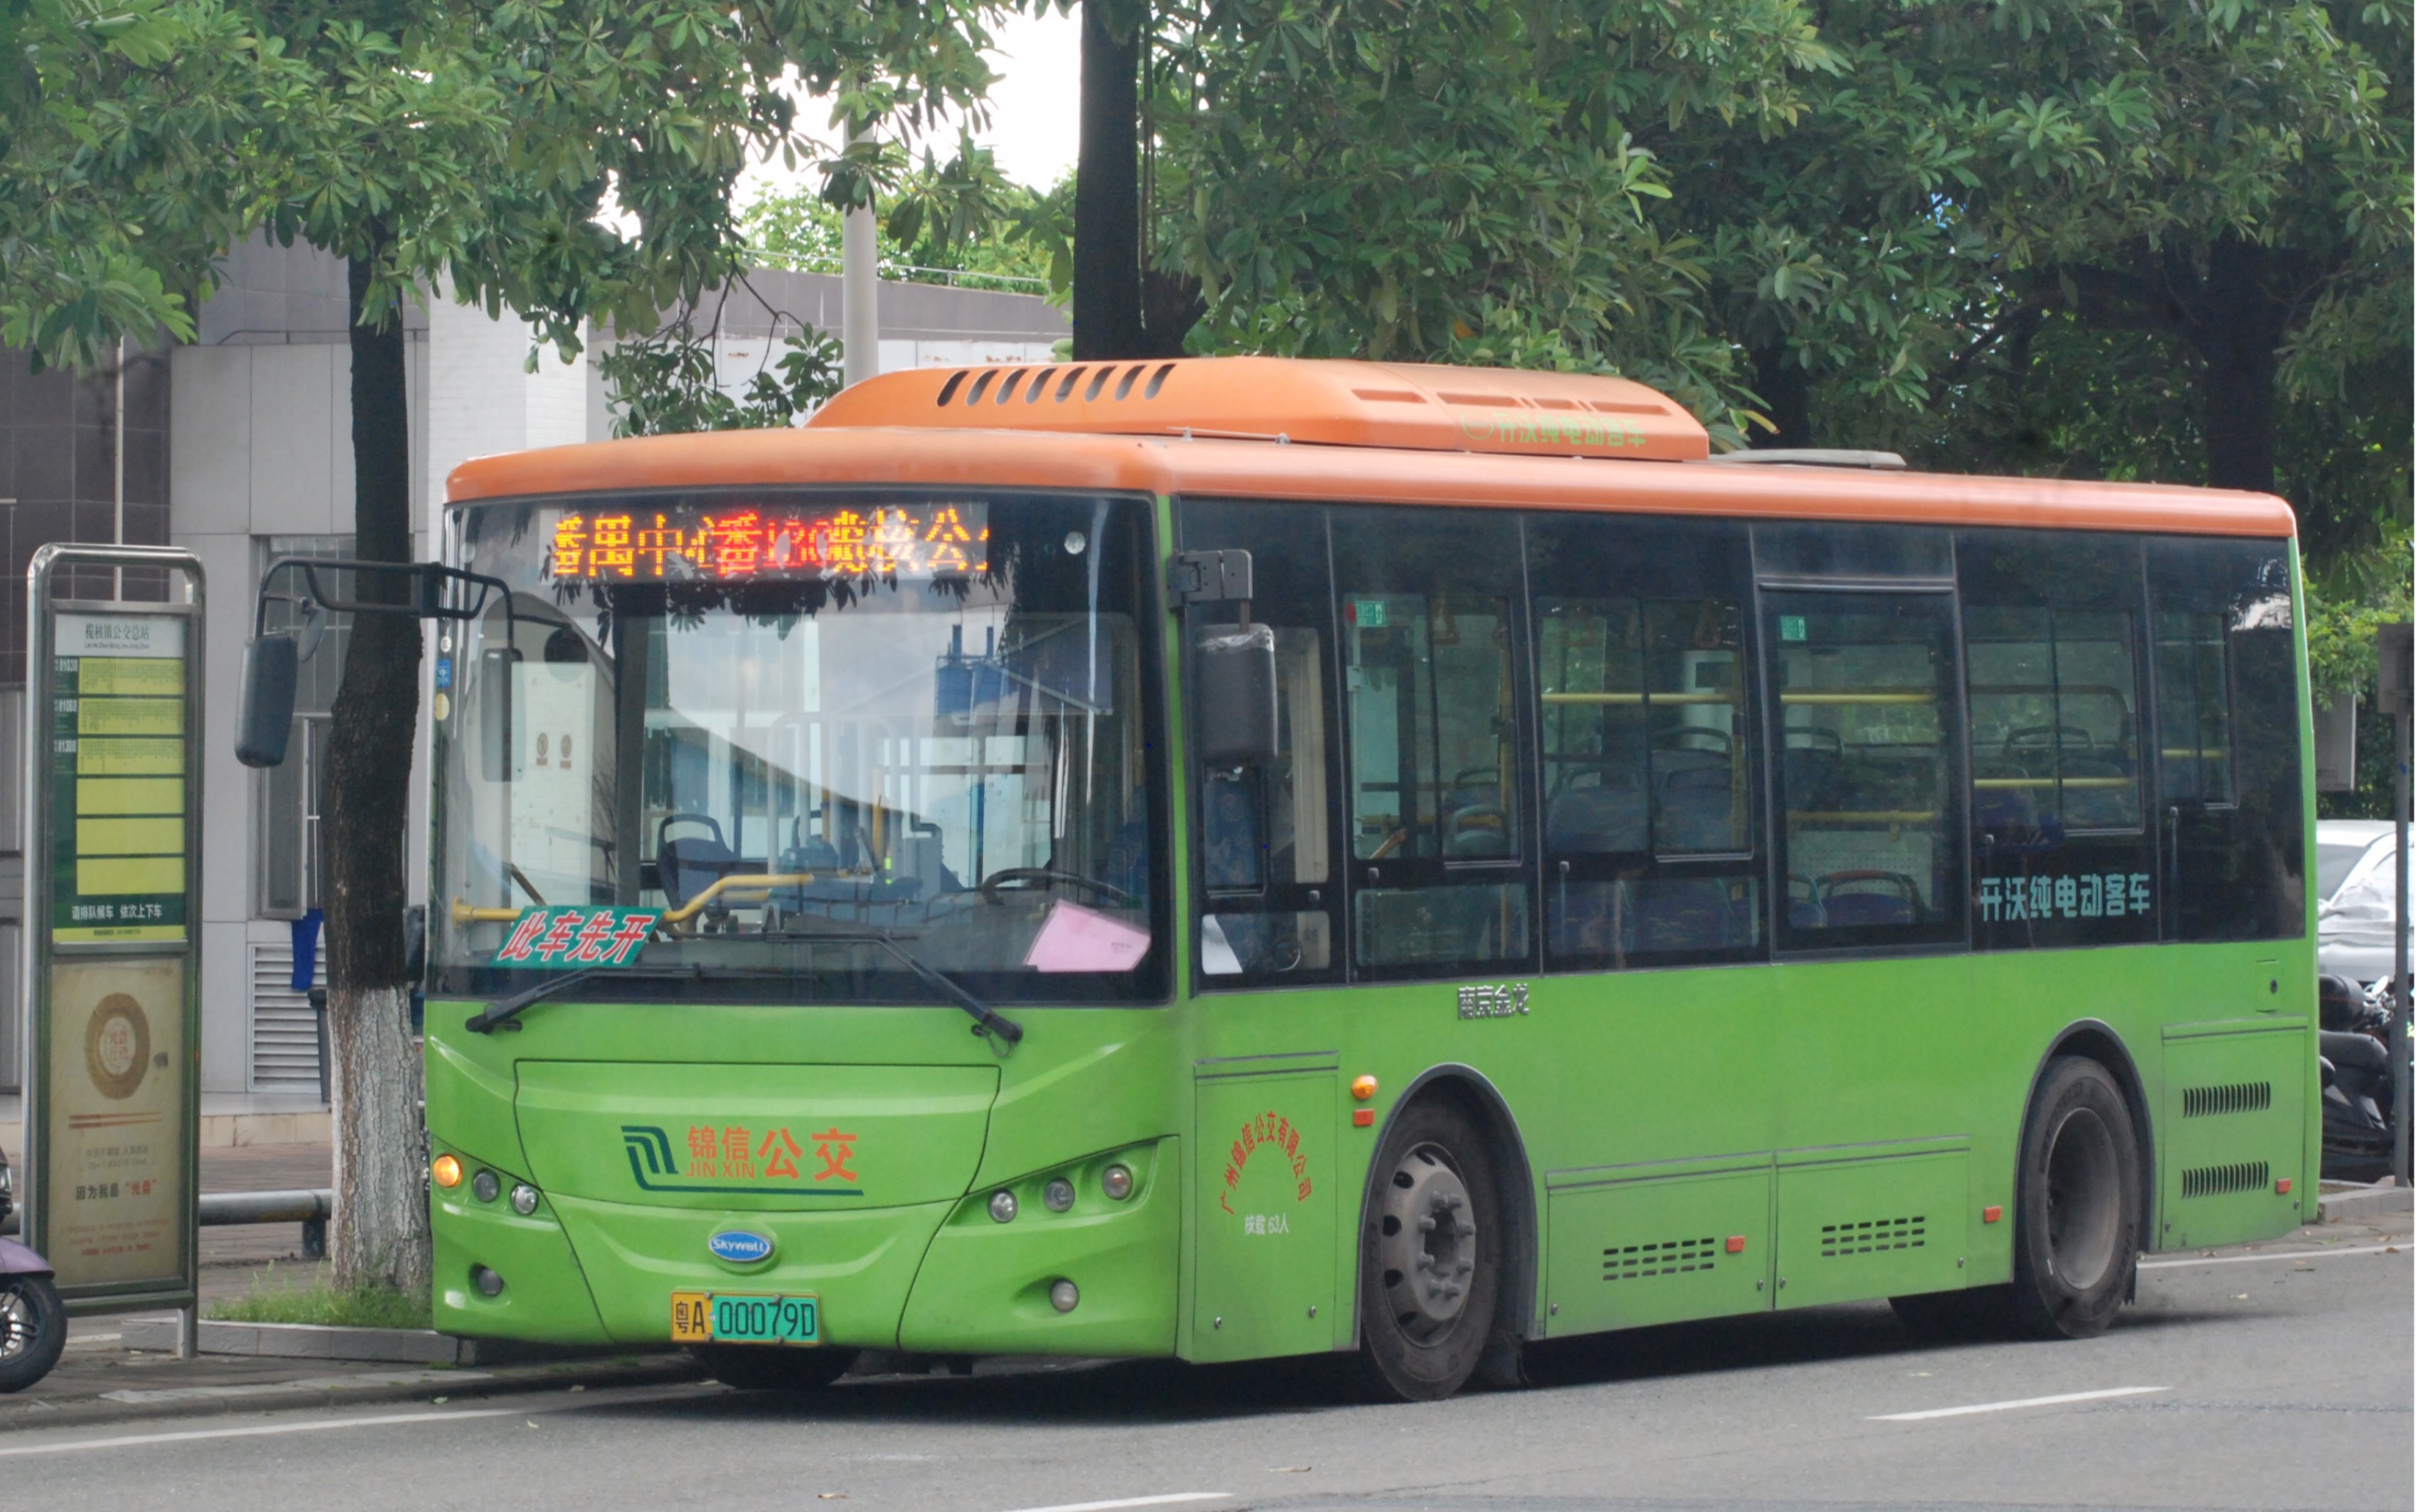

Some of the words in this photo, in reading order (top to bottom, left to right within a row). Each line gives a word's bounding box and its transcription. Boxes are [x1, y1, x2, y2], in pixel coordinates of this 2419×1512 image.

[120, 903, 162, 919] 依次上下车
[1980, 873, 2151, 921] 开沃纯电动客车
[497, 909, 656, 963] 此车先开
[1458, 983, 1529, 1020] 南京金龙
[686, 1161, 716, 1178] JIN
[723, 1161, 756, 1179] XIN
[687, 1125, 751, 1162] 锦信
[757, 1127, 859, 1183] 公交
[713, 1238, 765, 1253] Skywell
[675, 1301, 706, 1334] 粤A
[719, 1301, 815, 1336] 00079D
